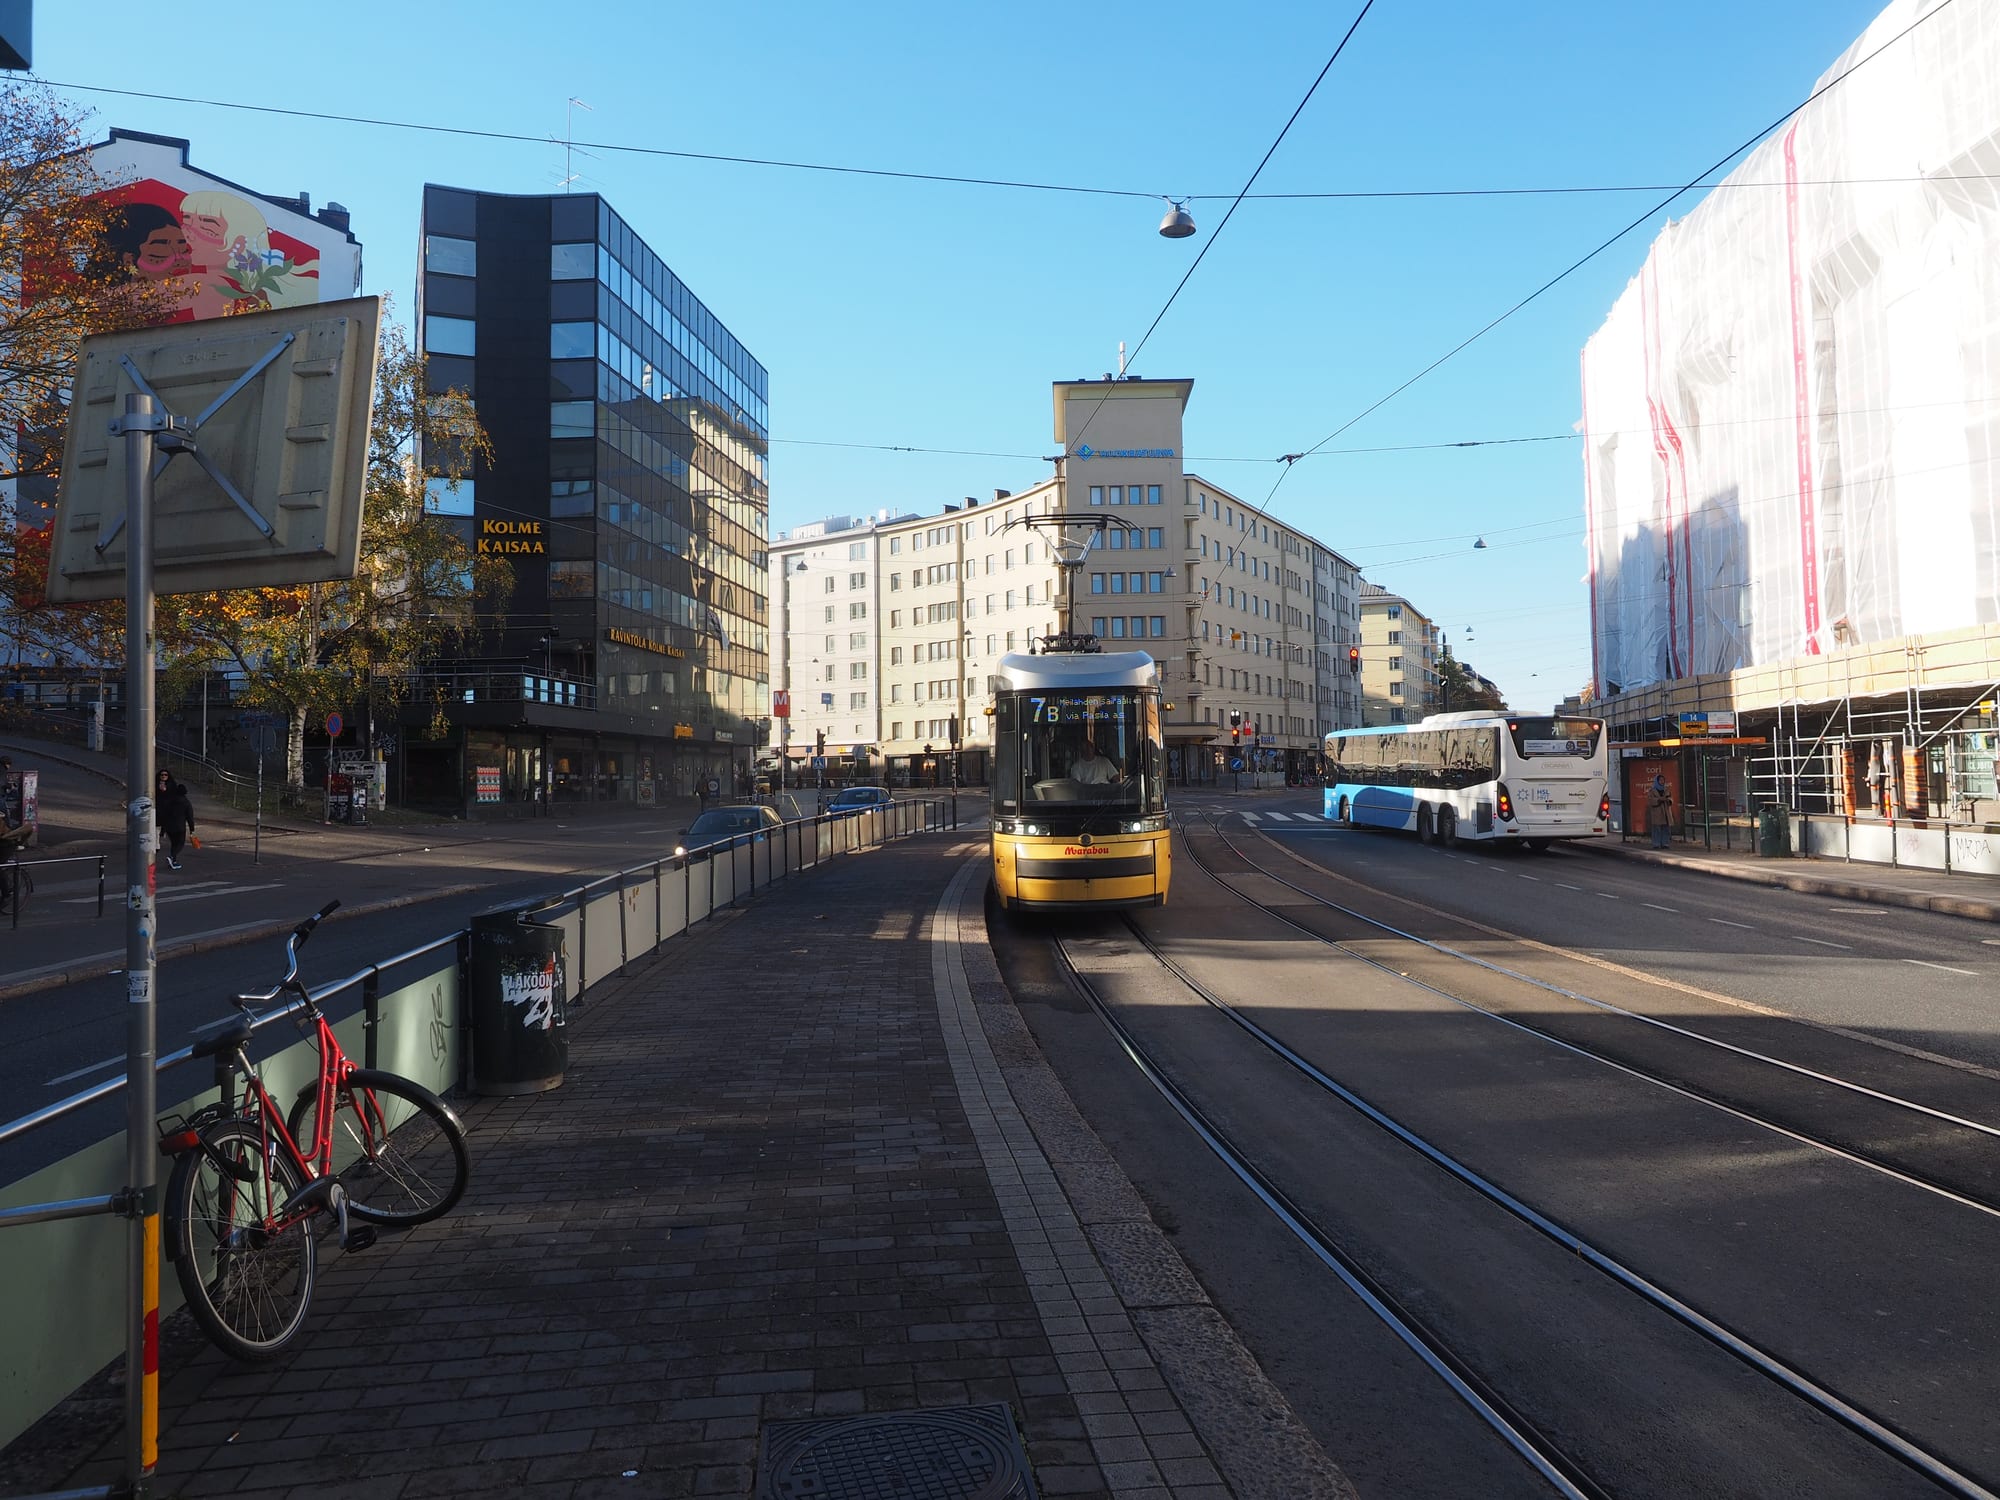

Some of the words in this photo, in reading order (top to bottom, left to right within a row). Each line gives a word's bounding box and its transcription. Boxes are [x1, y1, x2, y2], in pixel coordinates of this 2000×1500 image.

[483, 519, 542, 534] KOLME
[477, 538, 545, 553] KAISAA
[610, 628, 646, 649] RAVINTOLA
[648, 640, 666, 654] KOLME
[667, 645, 685, 658] KAISAA
[774, 692, 788, 706] M
[1065, 711, 1080, 720] via
[1082, 711, 1109, 720] Pasila
[1689, 713, 1698, 722] 14
[1065, 846, 1109, 855] Marabou
